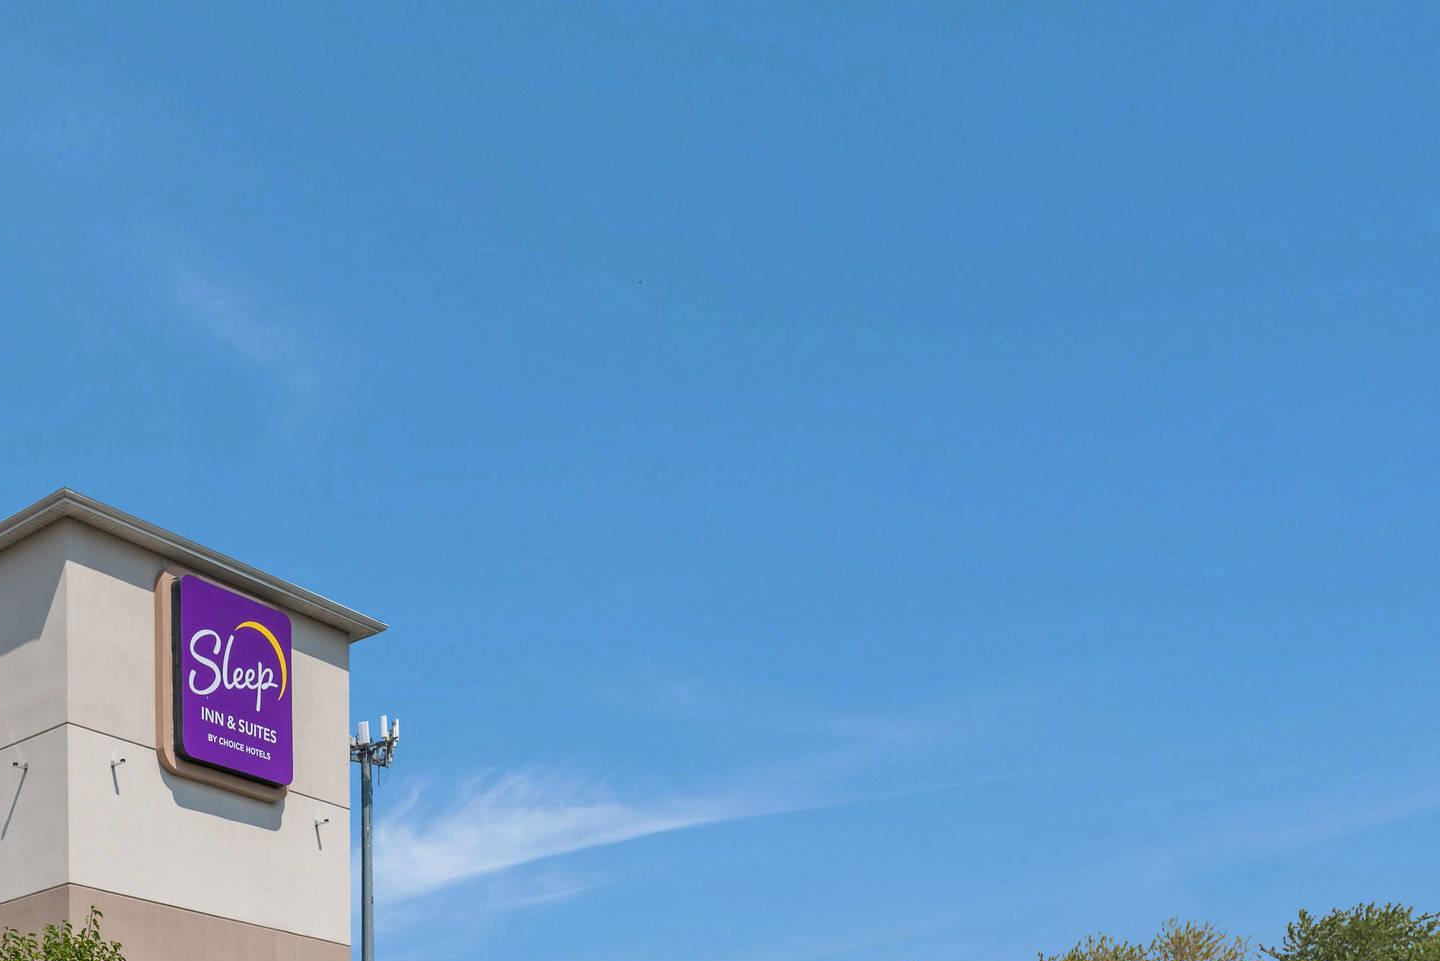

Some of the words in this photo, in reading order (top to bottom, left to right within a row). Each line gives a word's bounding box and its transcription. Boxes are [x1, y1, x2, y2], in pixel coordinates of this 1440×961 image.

[188, 629, 279, 712] Sleep
[201, 706, 224, 727] INN
[227, 715, 236, 730] &
[238, 719, 277, 743] SUITES
[208, 733, 218, 743] BY
[219, 737, 245, 752] CHOICE
[246, 745, 271, 761] HOTELS
